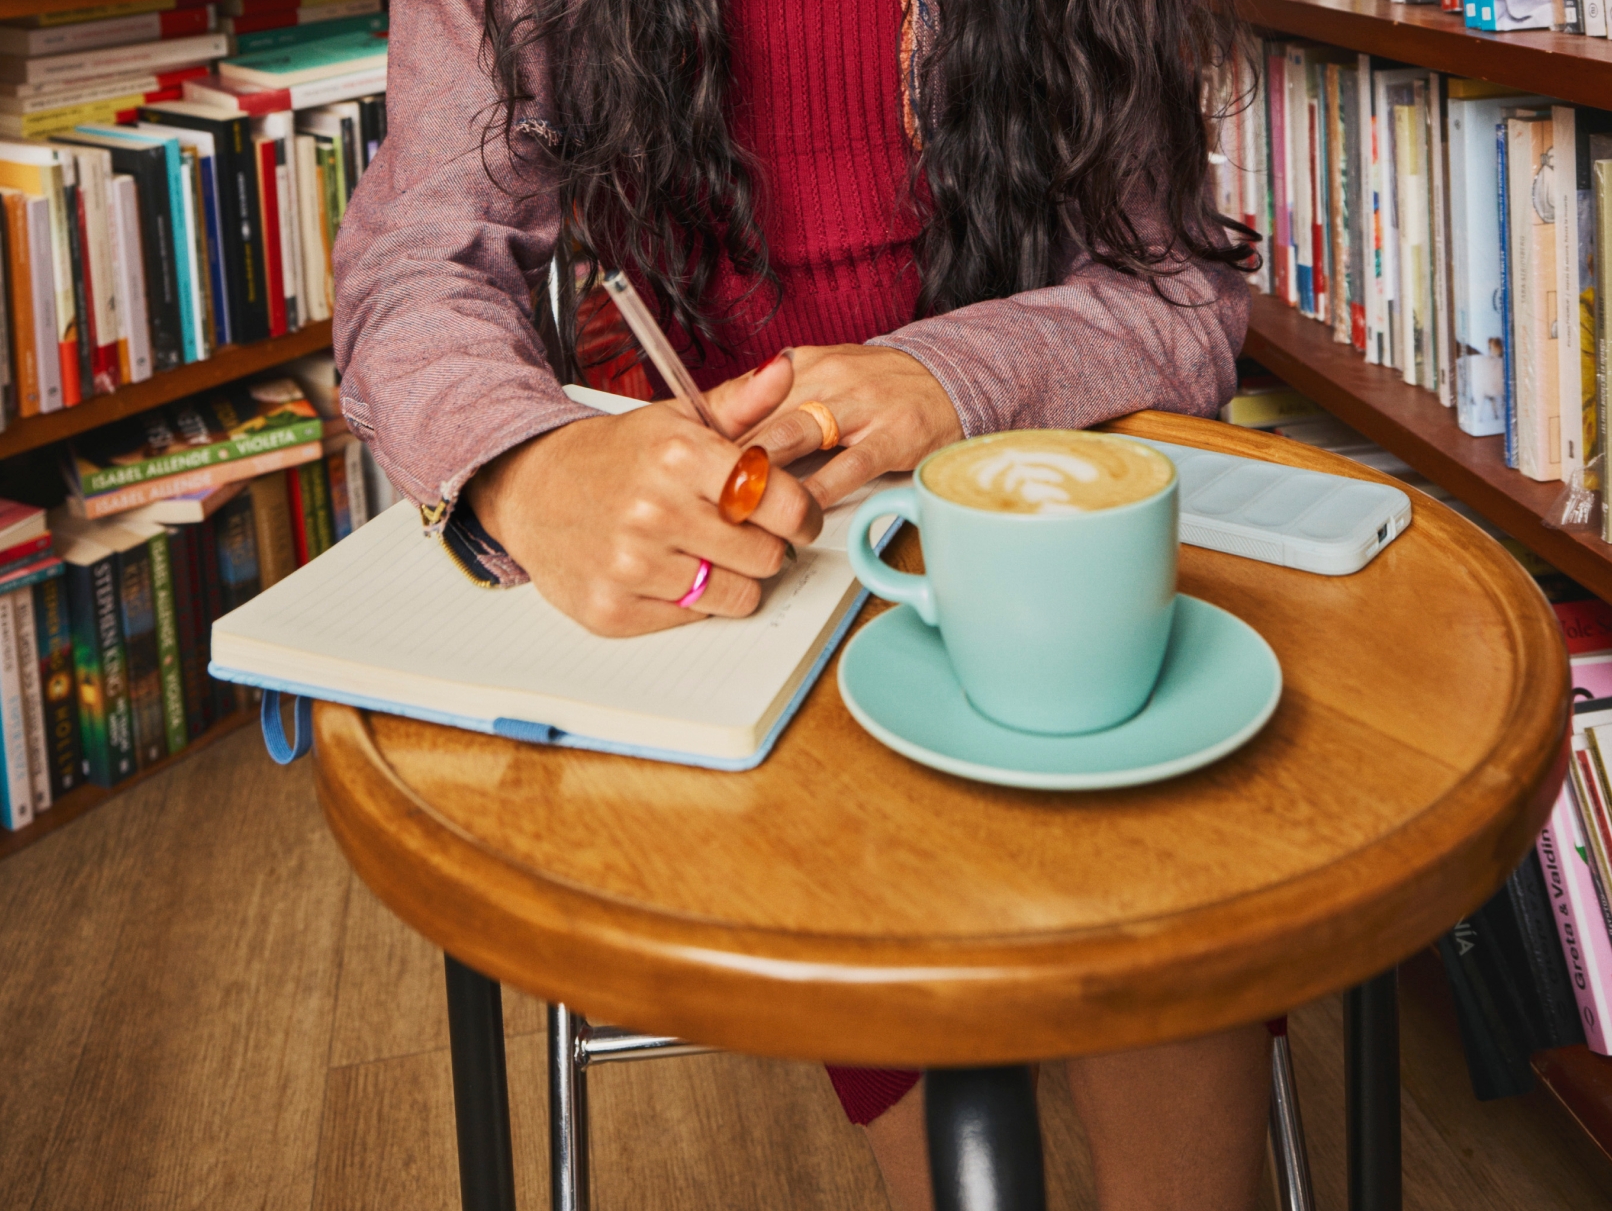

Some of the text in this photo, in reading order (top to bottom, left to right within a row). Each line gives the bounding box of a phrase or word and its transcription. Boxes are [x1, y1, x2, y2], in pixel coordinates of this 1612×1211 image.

[91, 430, 296, 490] ISABEL ALLENDE VIOLETA
[96, 492, 145, 515] ISABEL
[153, 541, 168, 588] ISABEL
[94, 563, 124, 697] STEPHEN KING
[158, 591, 174, 648] ALLENDE
[166, 670, 182, 729] VIOLETA
[55, 707, 73, 776] HOLLY
[1541, 828, 1586, 991] Greta & Valdin
